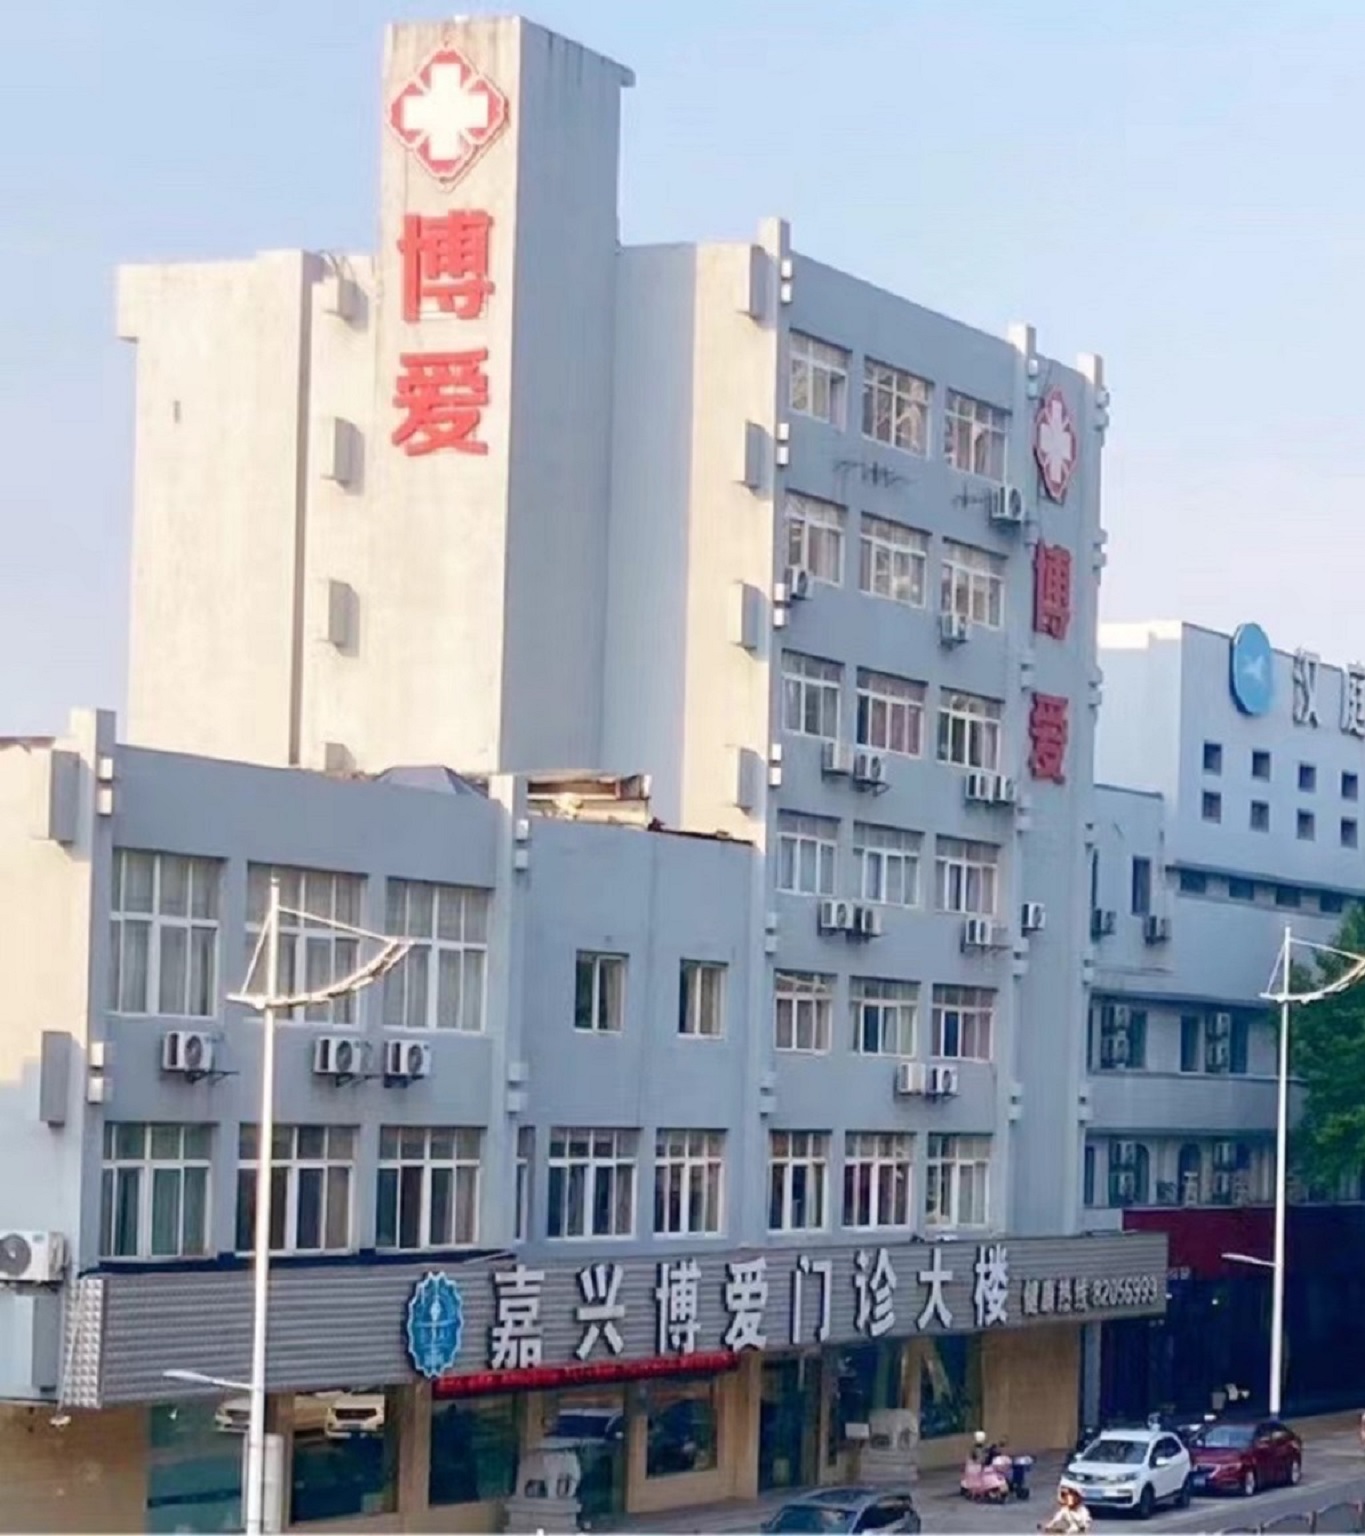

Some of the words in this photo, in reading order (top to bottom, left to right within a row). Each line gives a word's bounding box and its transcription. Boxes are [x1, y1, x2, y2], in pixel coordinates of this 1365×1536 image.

[391, 208, 495, 457] 博爱
[1027, 537, 1072, 786] 博爱
[488, 1243, 1008, 1371] 嘉兴博爱门诊大楼
